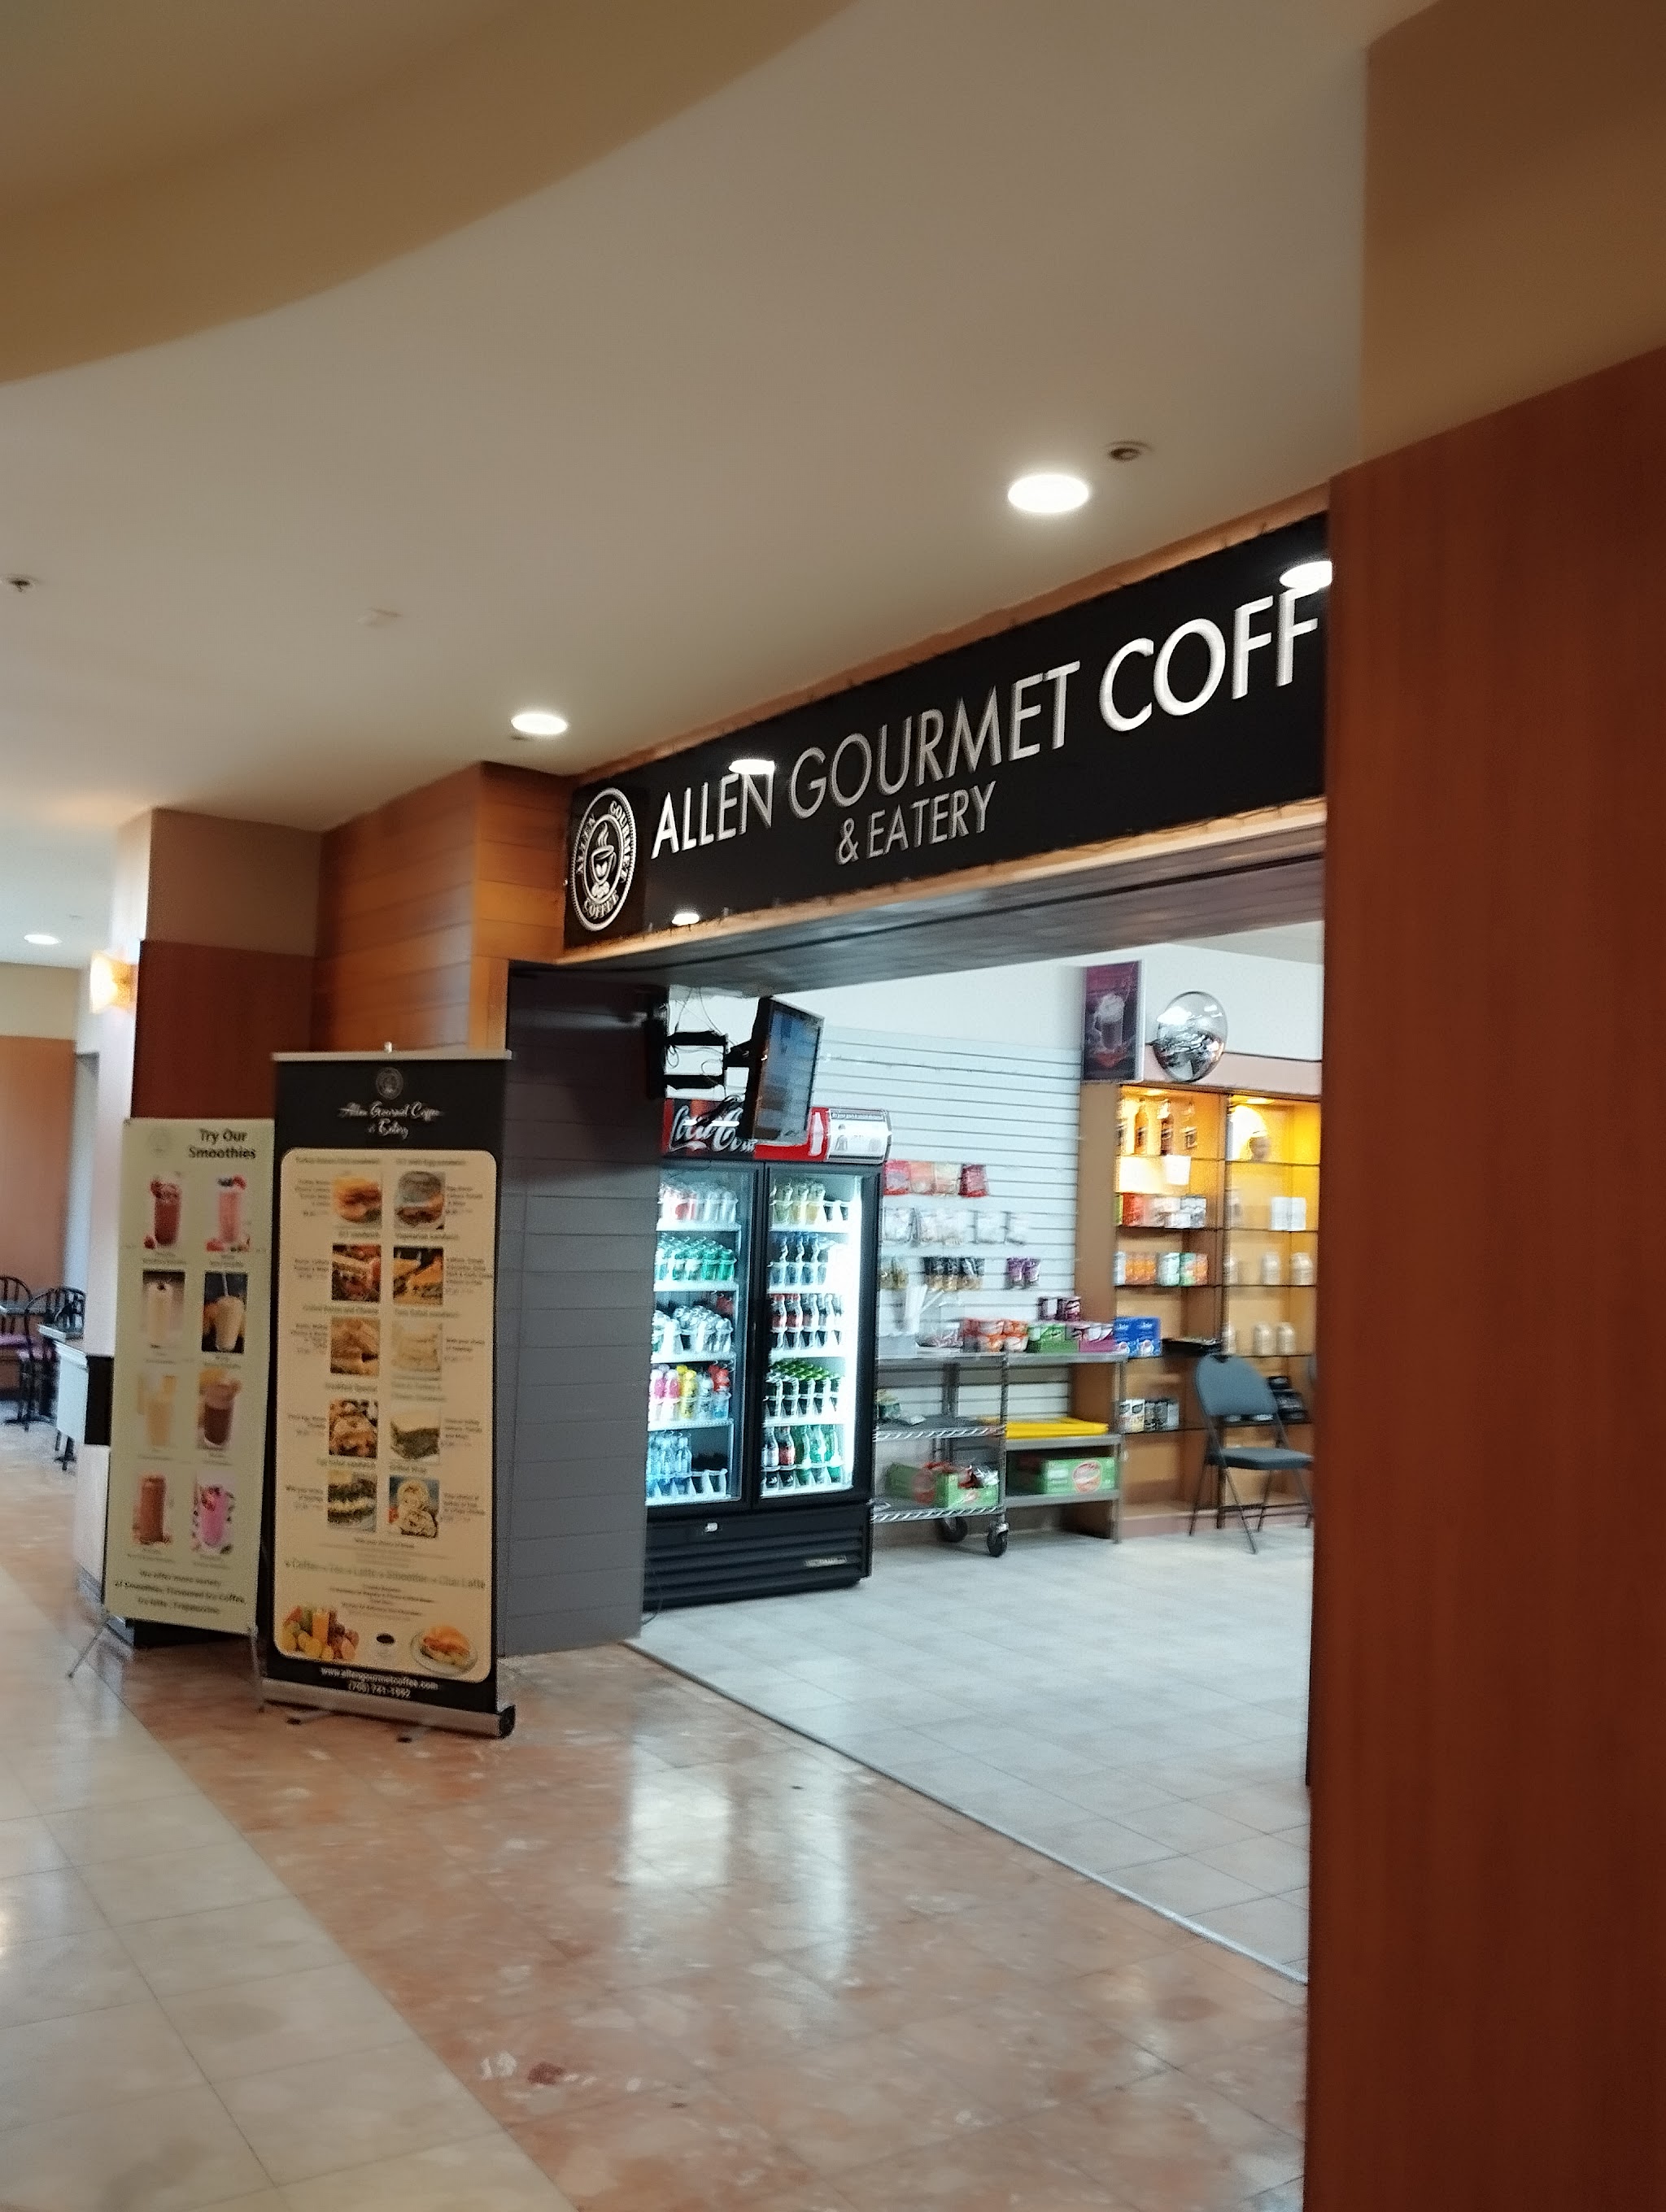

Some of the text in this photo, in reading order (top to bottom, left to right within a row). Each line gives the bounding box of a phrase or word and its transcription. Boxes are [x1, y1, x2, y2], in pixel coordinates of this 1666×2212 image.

[650, 586, 1318, 860] ALLEN GOURMET COFF
[608, 800, 632, 883] GOURMET
[836, 780, 997, 865] & EATERY
[582, 888, 620, 921] COFFEE
[188, 1144, 256, 1160] Smoothies
[198, 1128, 247, 1145] Try Our
